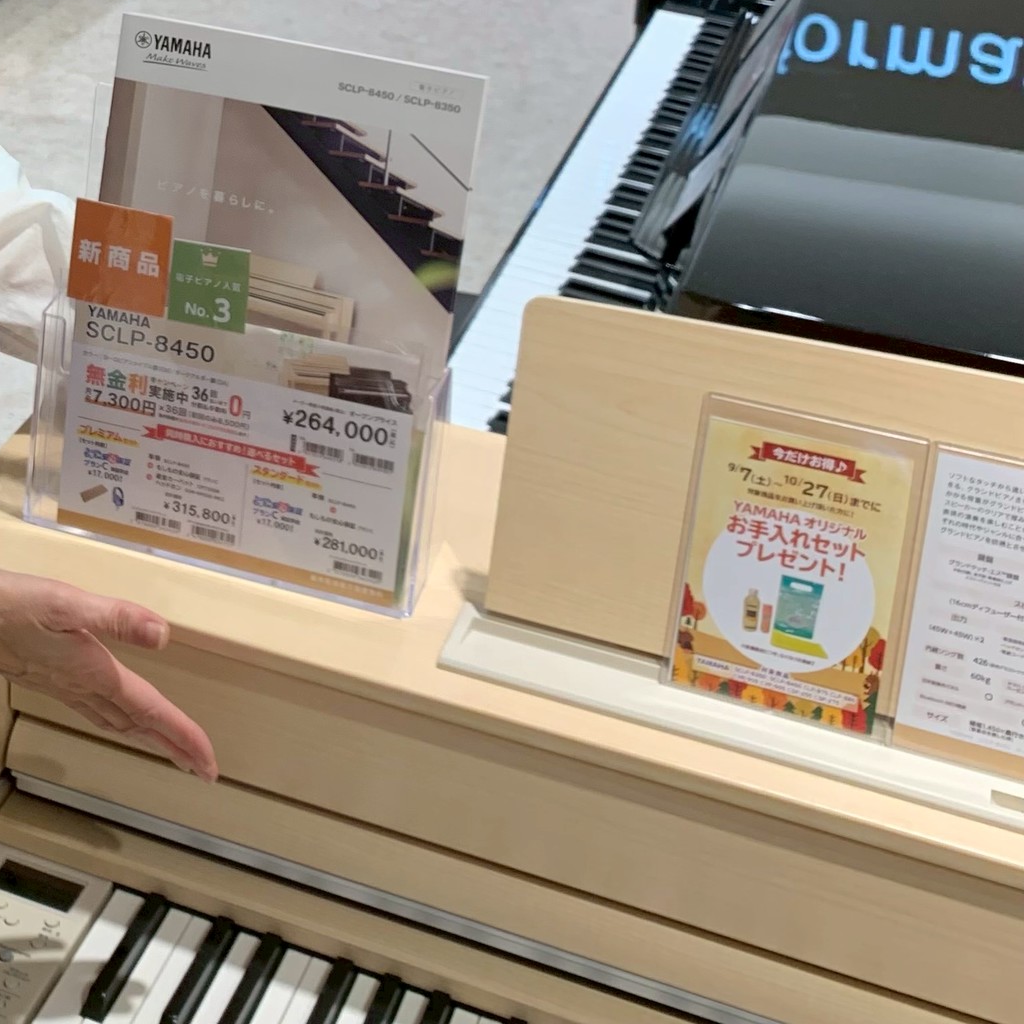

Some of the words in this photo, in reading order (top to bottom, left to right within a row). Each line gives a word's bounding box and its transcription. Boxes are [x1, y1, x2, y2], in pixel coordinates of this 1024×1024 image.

[145, 53, 174, 64] Make
[175, 58, 207, 69] Waves
[154, 34, 211, 59] YAMAHA
[157, 179, 275, 215] ピアノを暮らしに。
[78, 238, 160, 278] 新商品
[87, 304, 151, 329] YAMAHA
[86, 320, 215, 363] SCLP-8450
[85, 363, 149, 397] 無金利
[148, 384, 188, 405] 実施中
[282, 409, 389, 446] ¥264,000
[727, 514, 866, 562] お手入れセット
[733, 500, 801, 526] YAMAHA
[804, 517, 867, 541] オリジナル
